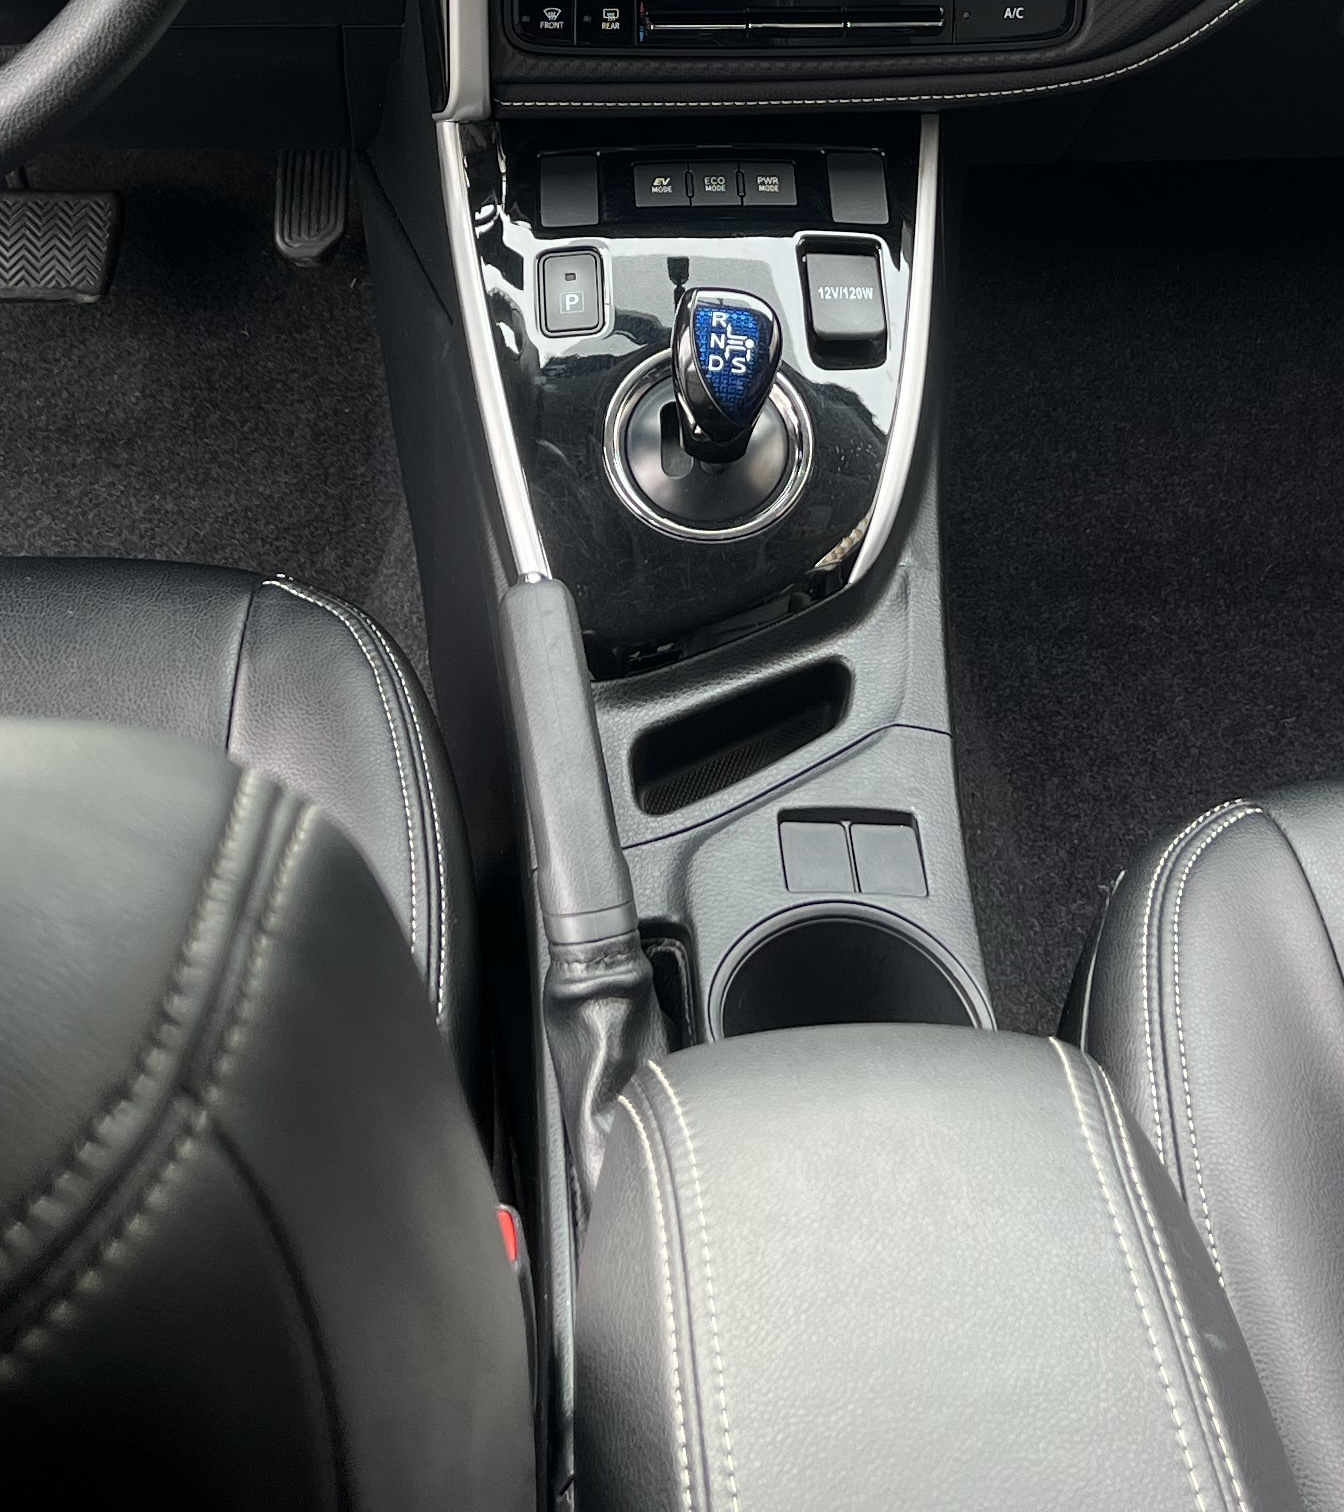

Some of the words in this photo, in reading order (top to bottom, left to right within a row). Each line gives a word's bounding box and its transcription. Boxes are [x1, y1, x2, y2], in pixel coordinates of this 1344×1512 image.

[1003, 6, 1024, 20] A/C
[540, 21, 564, 29] FRONT
[601, 22, 620, 30] REAR
[704, 177, 725, 185] ECO
[757, 177, 779, 185] PWR
[817, 286, 873, 300] 12V/120W
[565, 294, 579, 310] P
[712, 312, 726, 327] R
[710, 334, 725, 348] N
[708, 355, 724, 371] D
[732, 357, 746, 374] S
